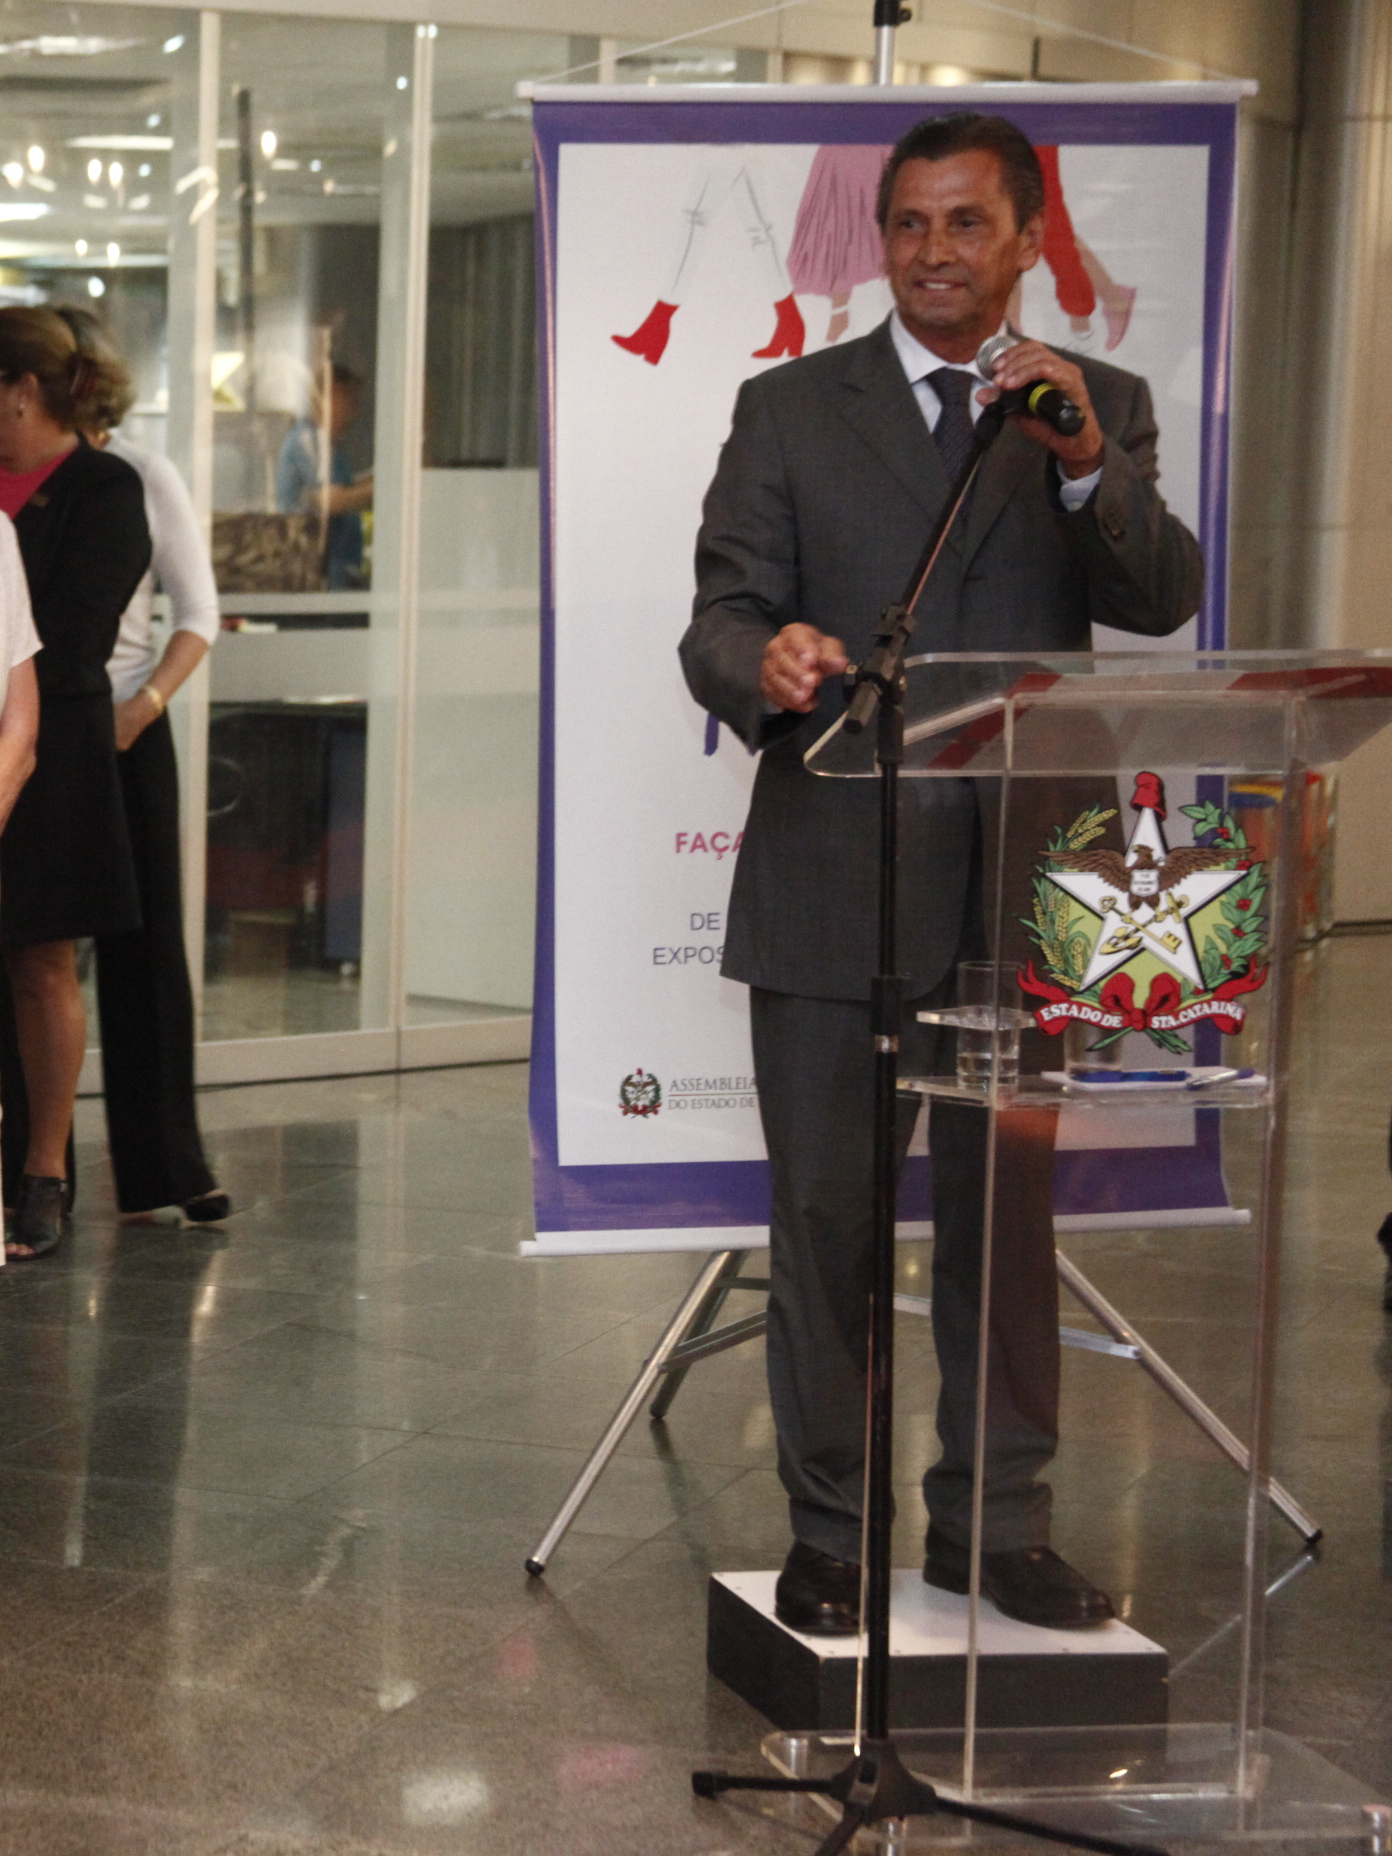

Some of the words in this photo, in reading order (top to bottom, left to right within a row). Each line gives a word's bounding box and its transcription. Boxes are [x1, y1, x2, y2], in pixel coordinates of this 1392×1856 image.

[690, 912, 722, 931] DE
[1040, 1002, 1103, 1022] ESTADO
[1099, 1013, 1123, 1029] DE
[1178, 1000, 1244, 1023] CATARINA
[669, 1076, 758, 1093] ASSEMBLEIA
[667, 1099, 688, 1111] DO
[691, 1098, 738, 1110] ESTADO
[739, 1096, 756, 1109] DE
